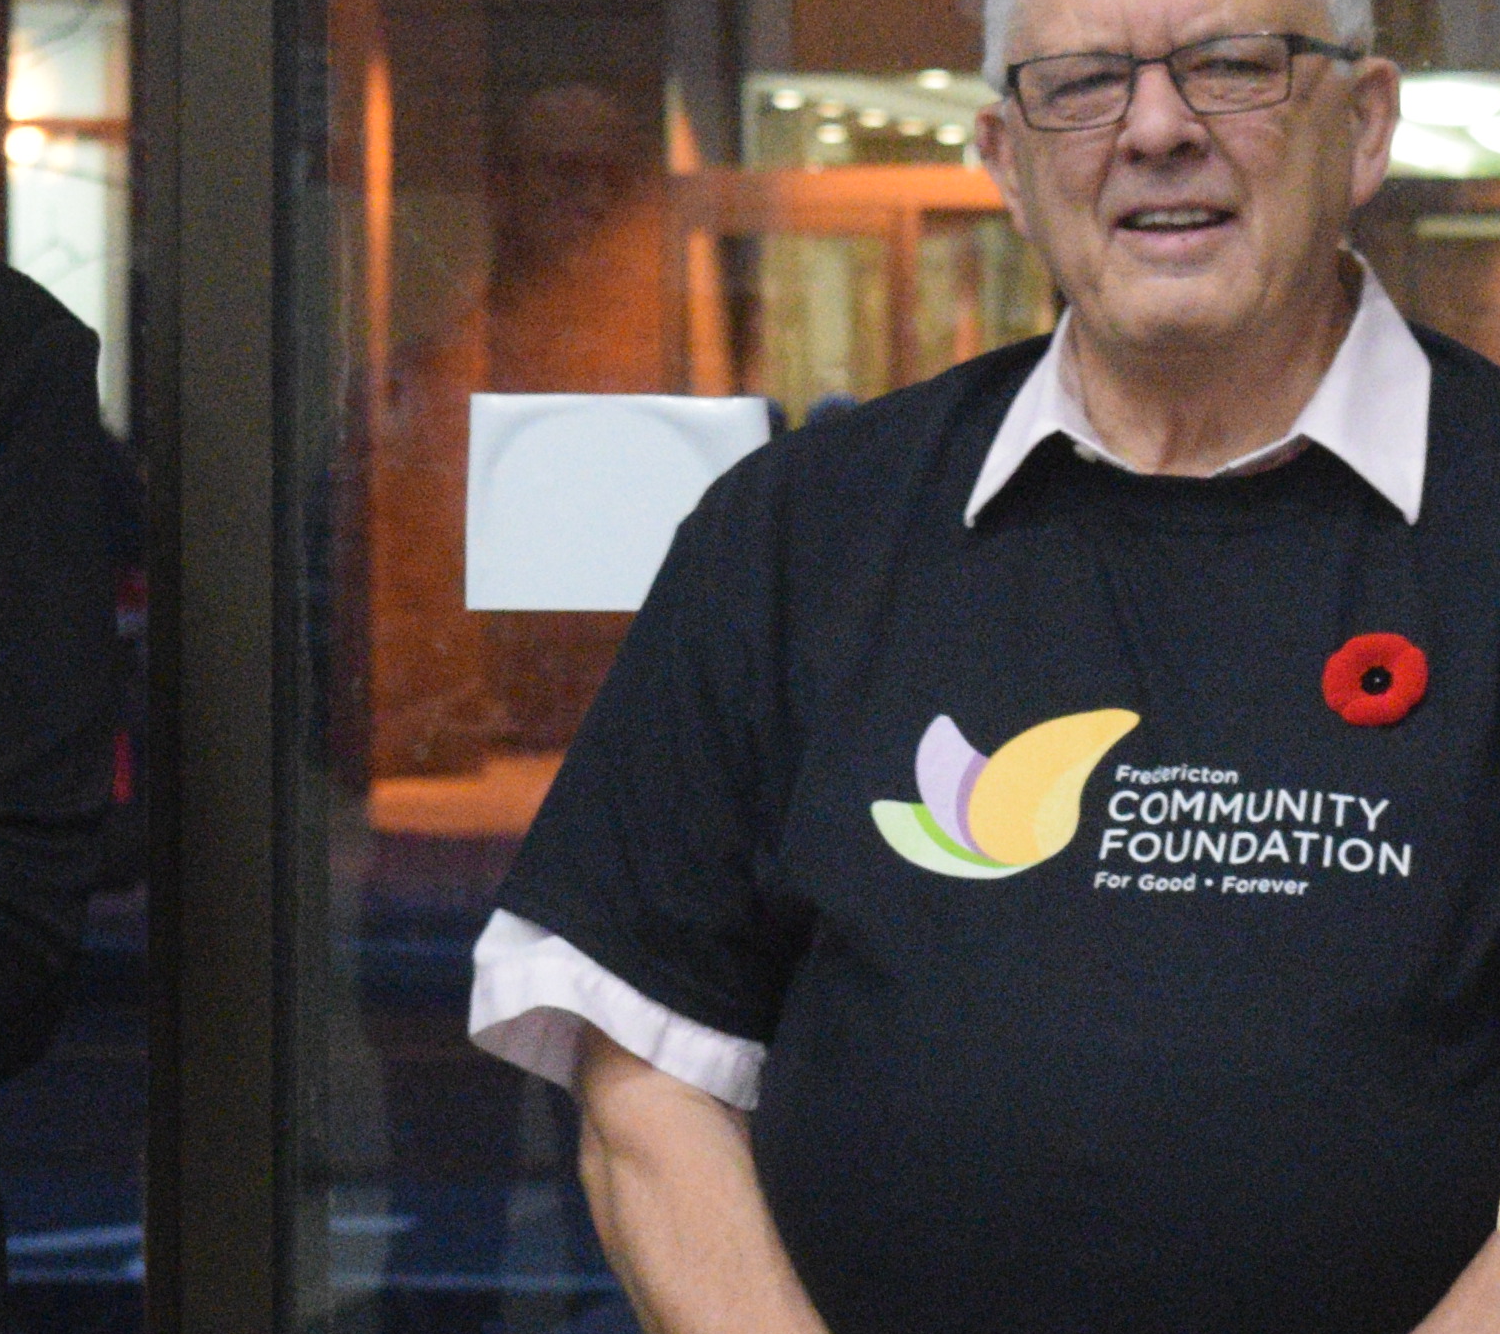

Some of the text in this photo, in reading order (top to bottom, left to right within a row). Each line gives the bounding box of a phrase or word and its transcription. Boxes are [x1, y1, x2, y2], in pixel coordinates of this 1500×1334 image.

[1115, 764, 1239, 785] Fredericton
[1107, 788, 1390, 832] COMMUNITY
[1098, 828, 1413, 878] FOUNDATION
[1094, 871, 1309, 896] For Good Forever
